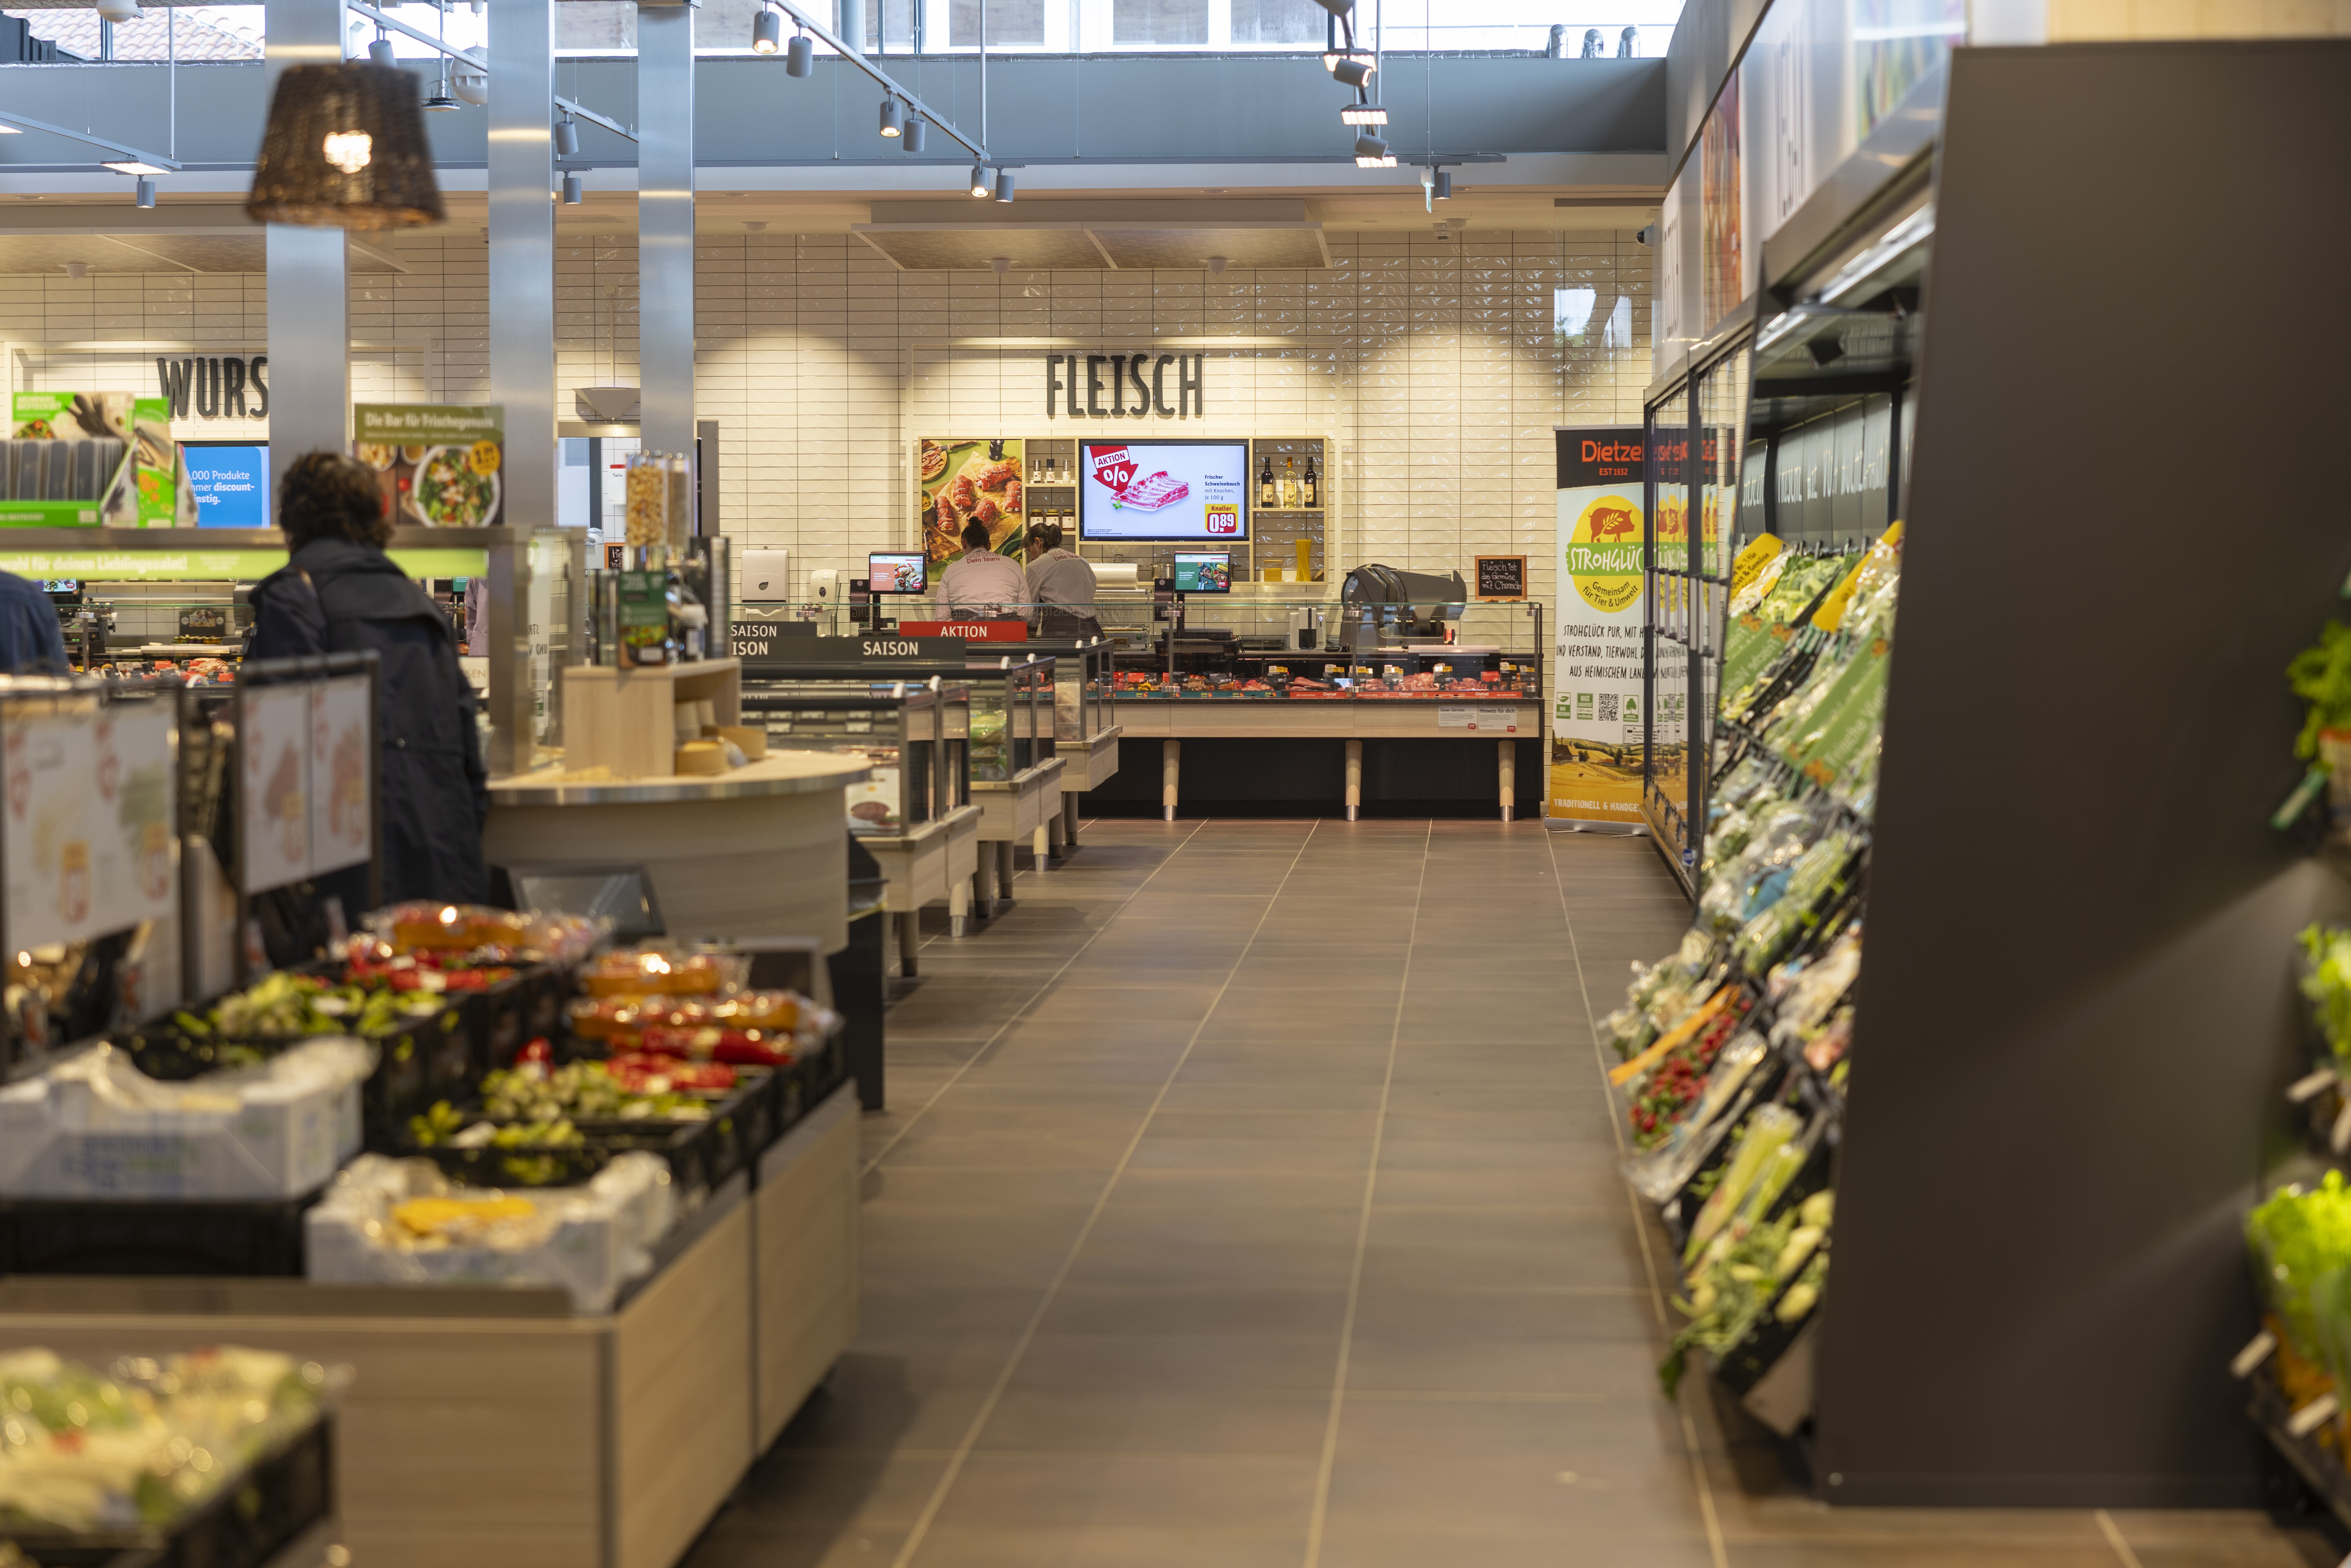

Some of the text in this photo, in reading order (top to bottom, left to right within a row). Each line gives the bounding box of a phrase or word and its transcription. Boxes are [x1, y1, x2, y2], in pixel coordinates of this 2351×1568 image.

[157, 357, 268, 418] WURS
[1046, 354, 1203, 420] FLEISCH
[365, 412, 384, 427] Die
[385, 413, 404, 427] Bar
[406, 412, 421, 427] für
[1098, 452, 1125, 466] AKTION
[212, 470, 250, 480] Produkte
[190, 482, 255, 491] mmer discount-
[1209, 514, 1234, 532] 0.89
[610, 547, 625, 558] Hie
[966, 551, 1000, 559] REWE
[1571, 545, 1643, 572] STROHGLÜC
[31, 555, 51, 571] für
[53, 555, 95, 571] deinen
[96, 555, 188, 574] Lieblingssalat!
[610, 558, 621, 567] mit
[1480, 560, 1517, 571] Fleisch ist
[1492, 572, 1516, 581] Gemüse
[1482, 580, 1493, 589] mit
[1592, 581, 1630, 596] Gemeinsam
[1583, 585, 1639, 607] für Tier & Umwelt
[730, 625, 777, 637] SAISON
[940, 626, 987, 637] AKTION
[1564, 623, 1605, 637] STROHGLÜCK
[1607, 626, 1622, 639] PUR,
[1625, 626, 1637, 638] MIT
[732, 641, 768, 655] ISON
[863, 641, 918, 655] SAISON
[1556, 644, 1566, 657] UND
[1569, 645, 1603, 659] VERSTAND,
[1606, 646, 1637, 659] TIERWOHL
[1569, 665, 1581, 677] AUS
[1585, 665, 1627, 679] HEIMISCHEM
[1554, 798, 1640, 812] TRADITIONELL & HANDGE
